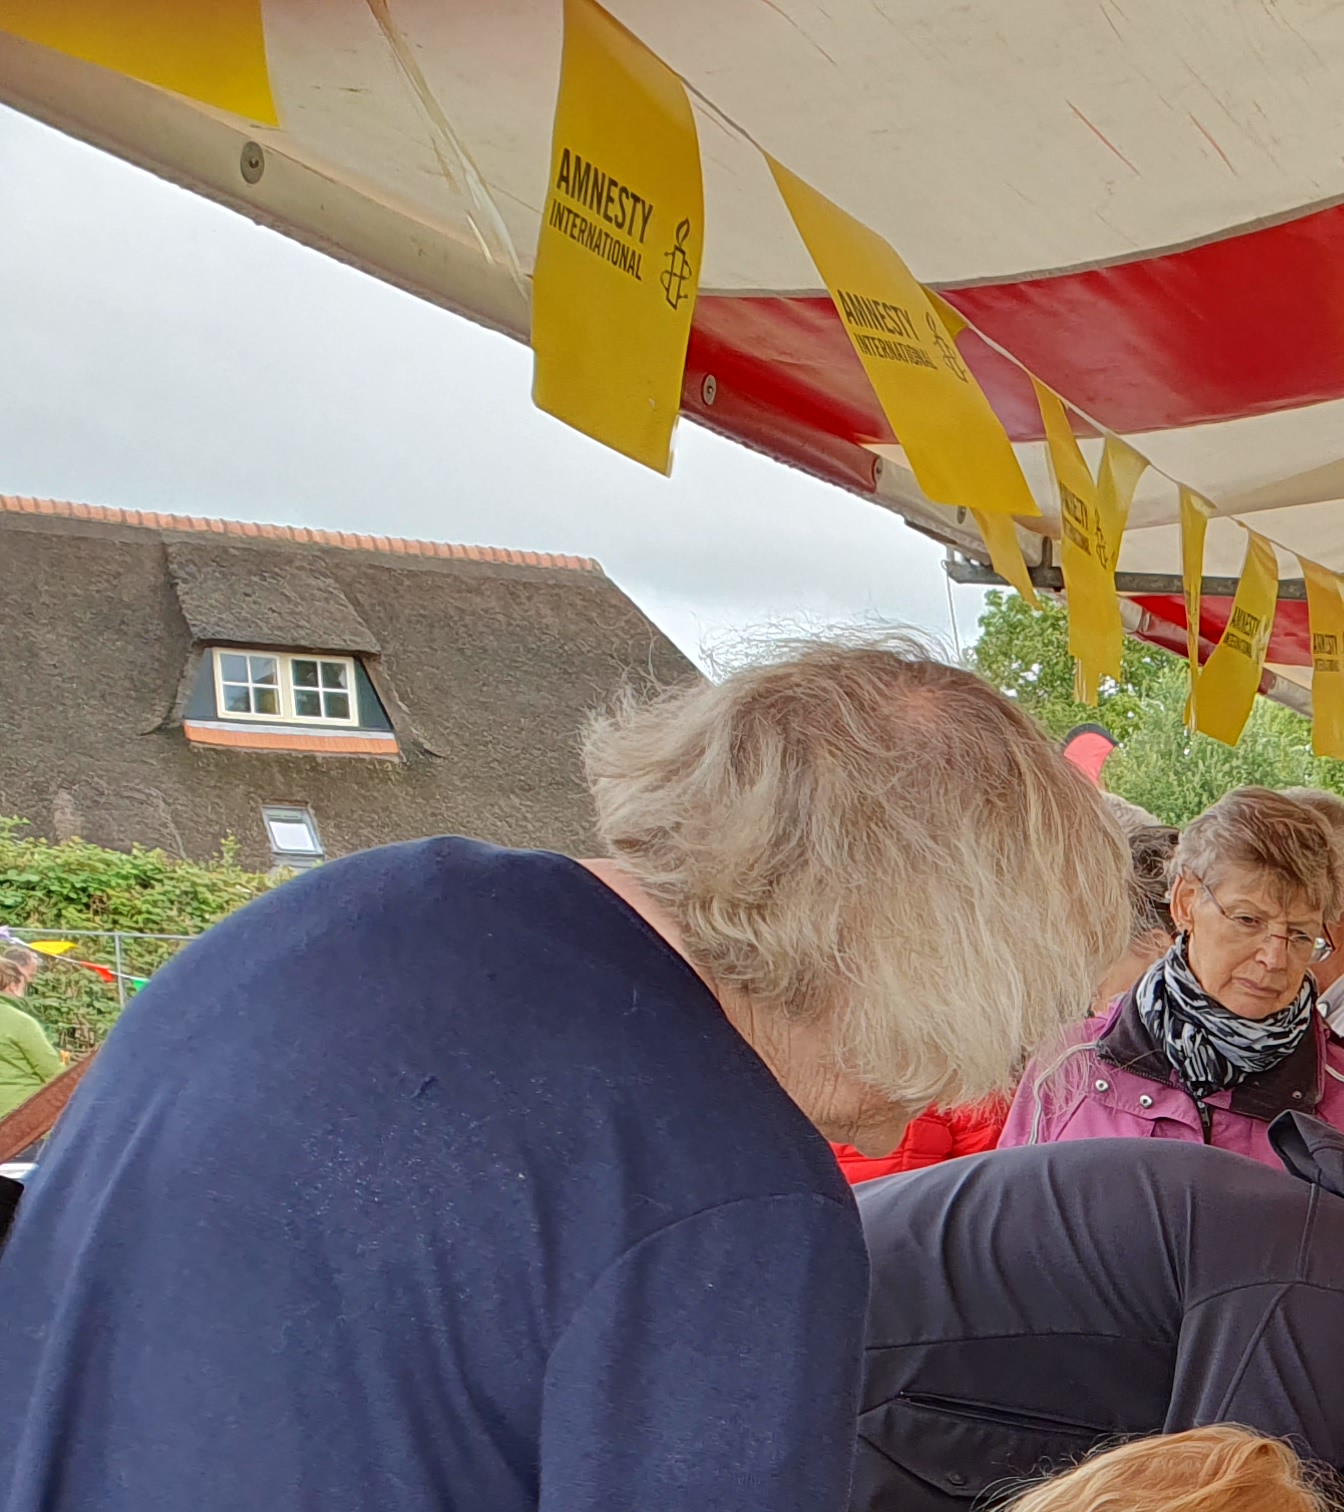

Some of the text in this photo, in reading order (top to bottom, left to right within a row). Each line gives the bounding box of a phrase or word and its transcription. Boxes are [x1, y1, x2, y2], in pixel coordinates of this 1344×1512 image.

[556, 147, 653, 244] AMNESTY
[549, 199, 642, 281] INTERNATIONAL
[837, 289, 919, 341] AMNESTY
